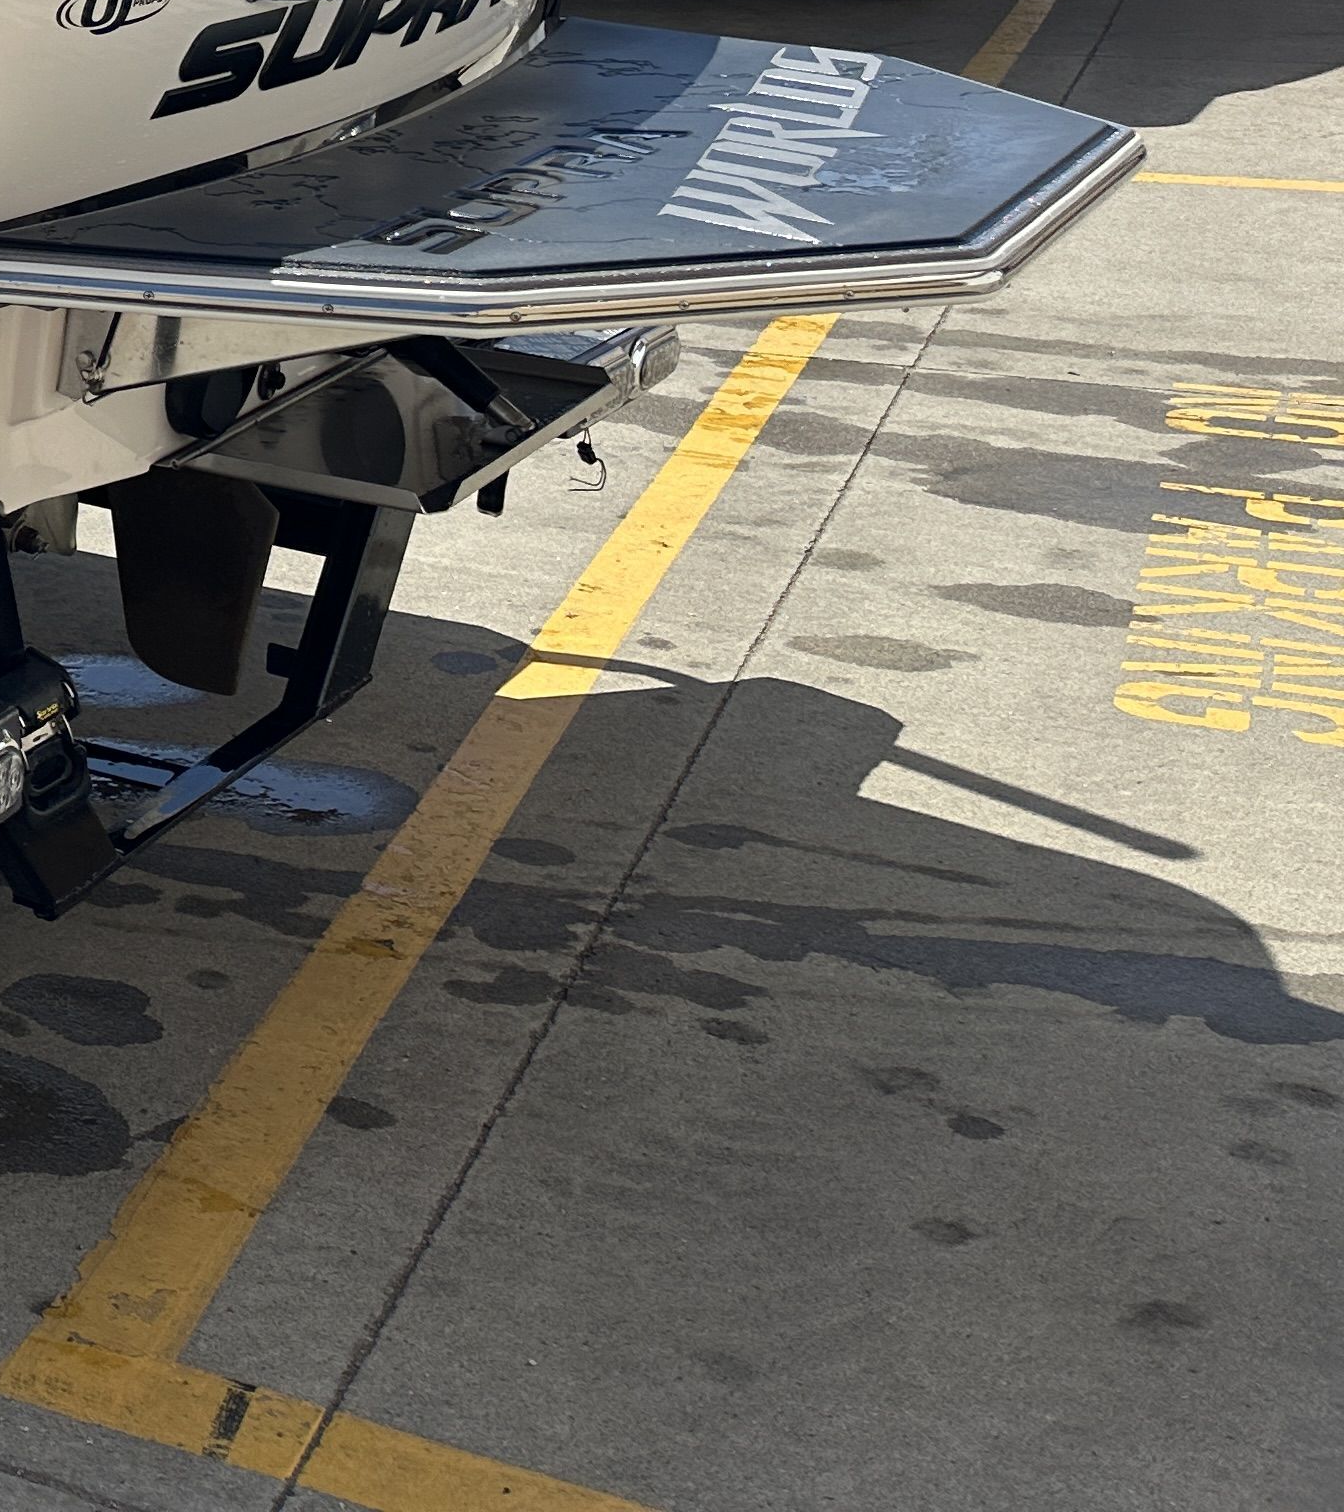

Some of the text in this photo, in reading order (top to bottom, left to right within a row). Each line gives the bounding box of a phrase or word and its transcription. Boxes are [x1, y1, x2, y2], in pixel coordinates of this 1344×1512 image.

[370, 126, 692, 253] SUPRA
[657, 45, 886, 243] WORLDS
[1113, 481, 1344, 746] PARKING
